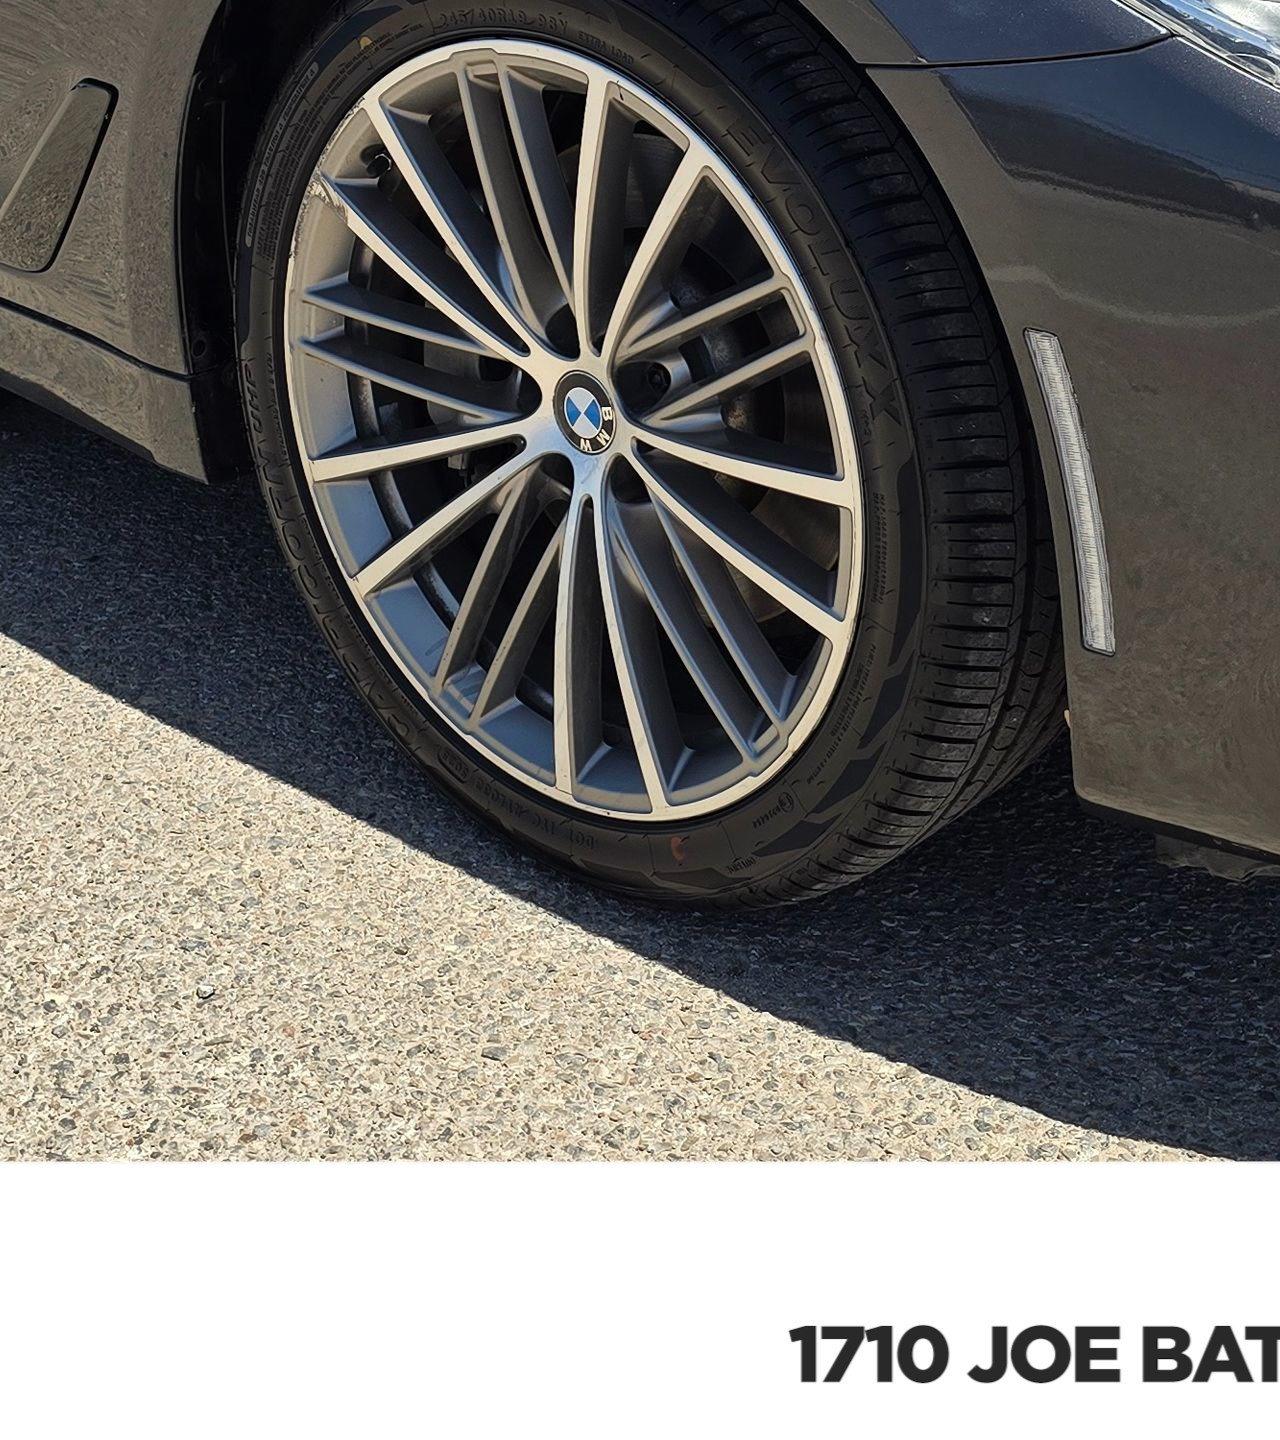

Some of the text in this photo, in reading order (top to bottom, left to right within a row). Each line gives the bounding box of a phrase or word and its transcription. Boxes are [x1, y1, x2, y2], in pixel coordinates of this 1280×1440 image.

[722, 118, 902, 428] EVOLUXX
[242, 360, 263, 436] UHP
[579, 406, 613, 452] BMW
[258, 452, 411, 738] CAPRICORN
